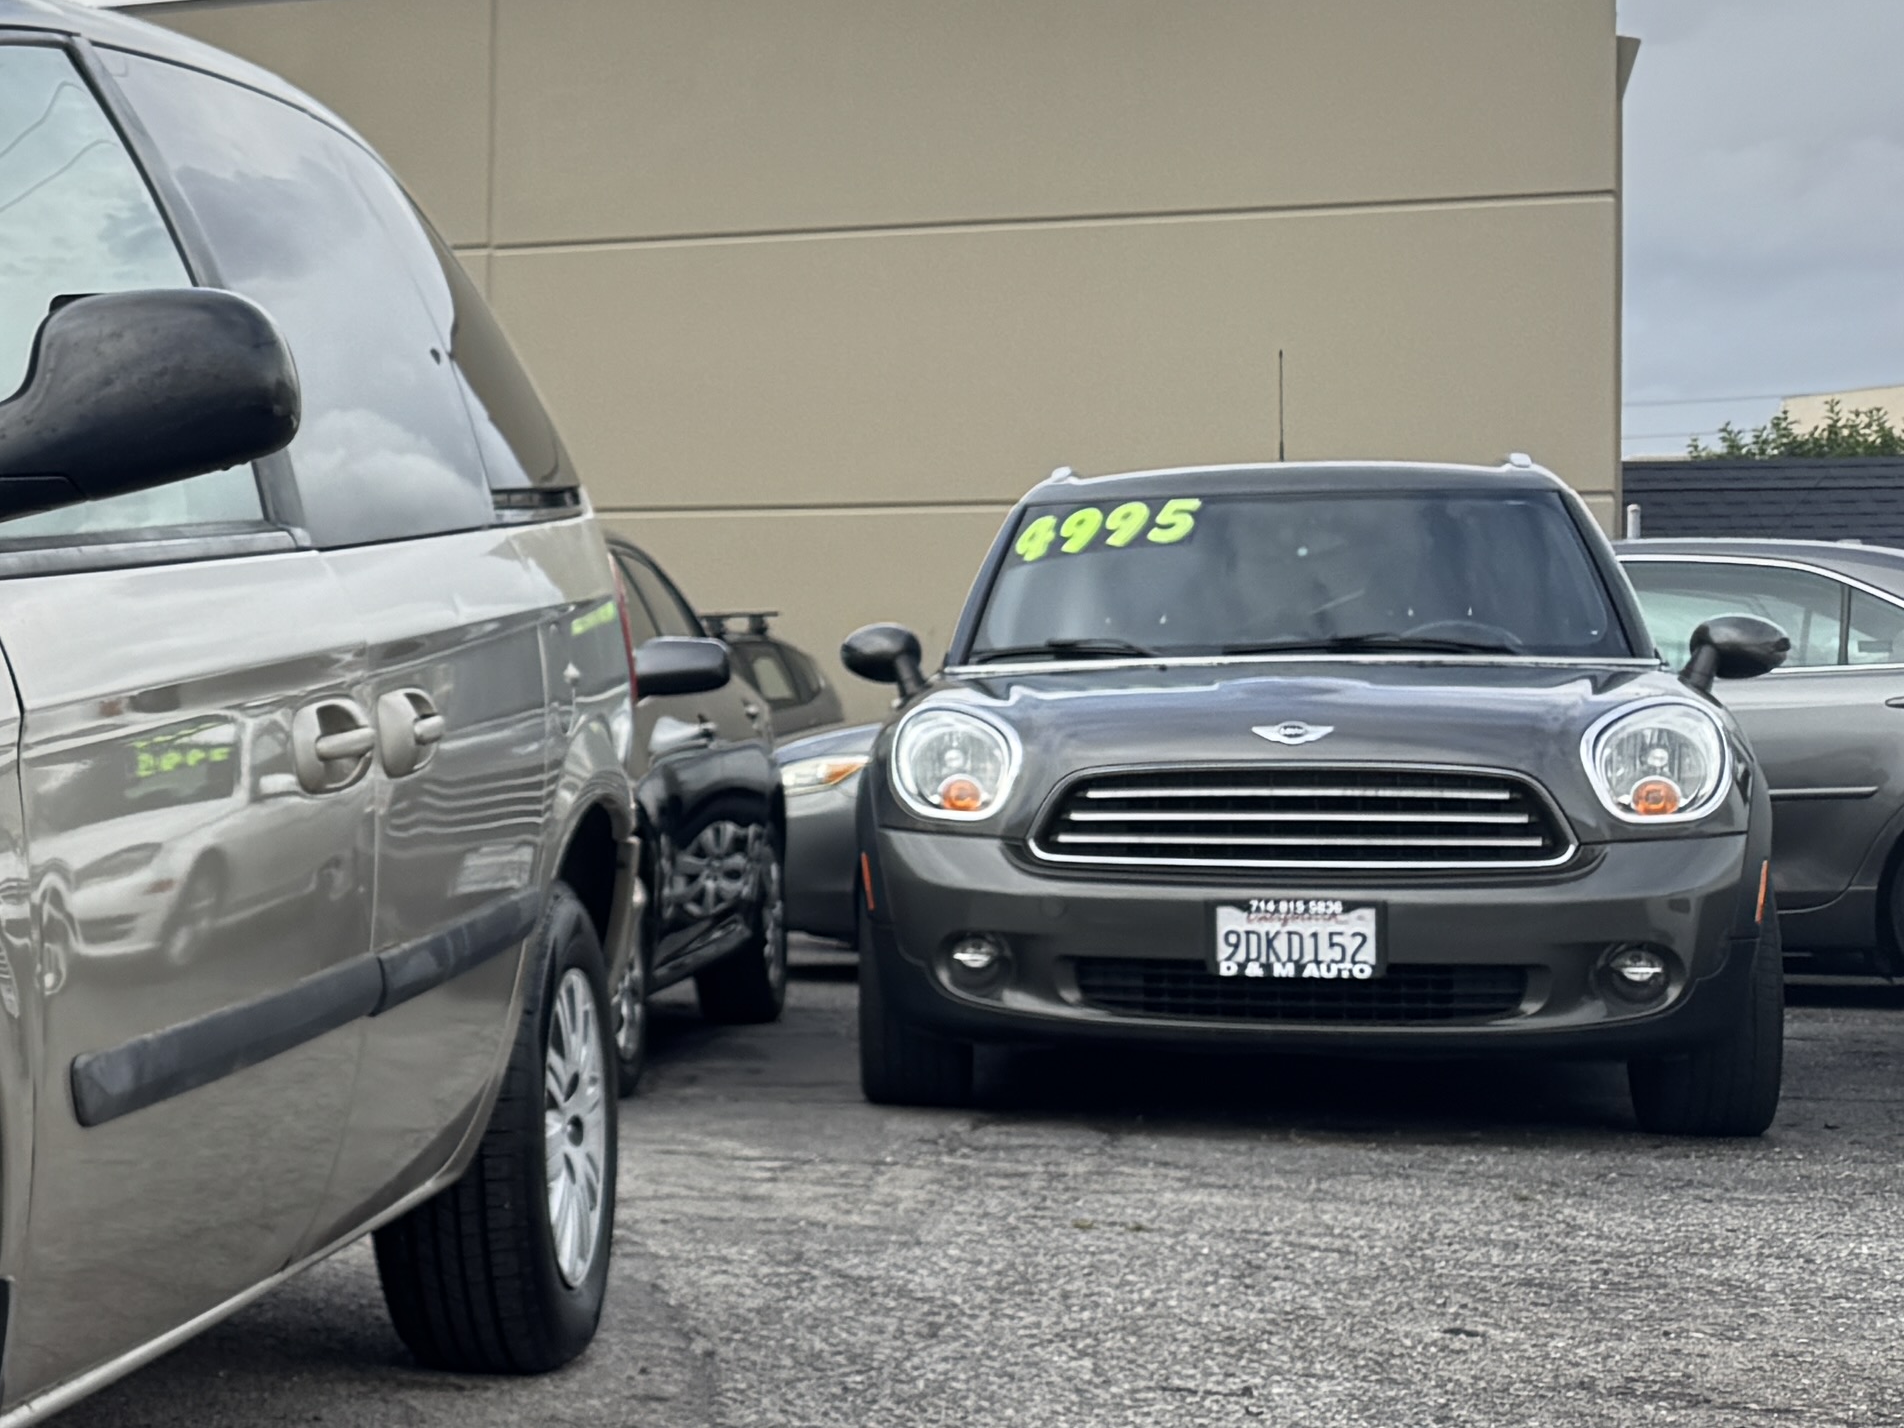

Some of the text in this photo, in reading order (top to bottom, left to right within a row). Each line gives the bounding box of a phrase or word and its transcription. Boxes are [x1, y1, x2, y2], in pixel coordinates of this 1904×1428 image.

[1015, 498, 1202, 562] 4995
[1223, 929, 1368, 965] 9DKD152
[1219, 961, 1373, 979] D & M AUTO
